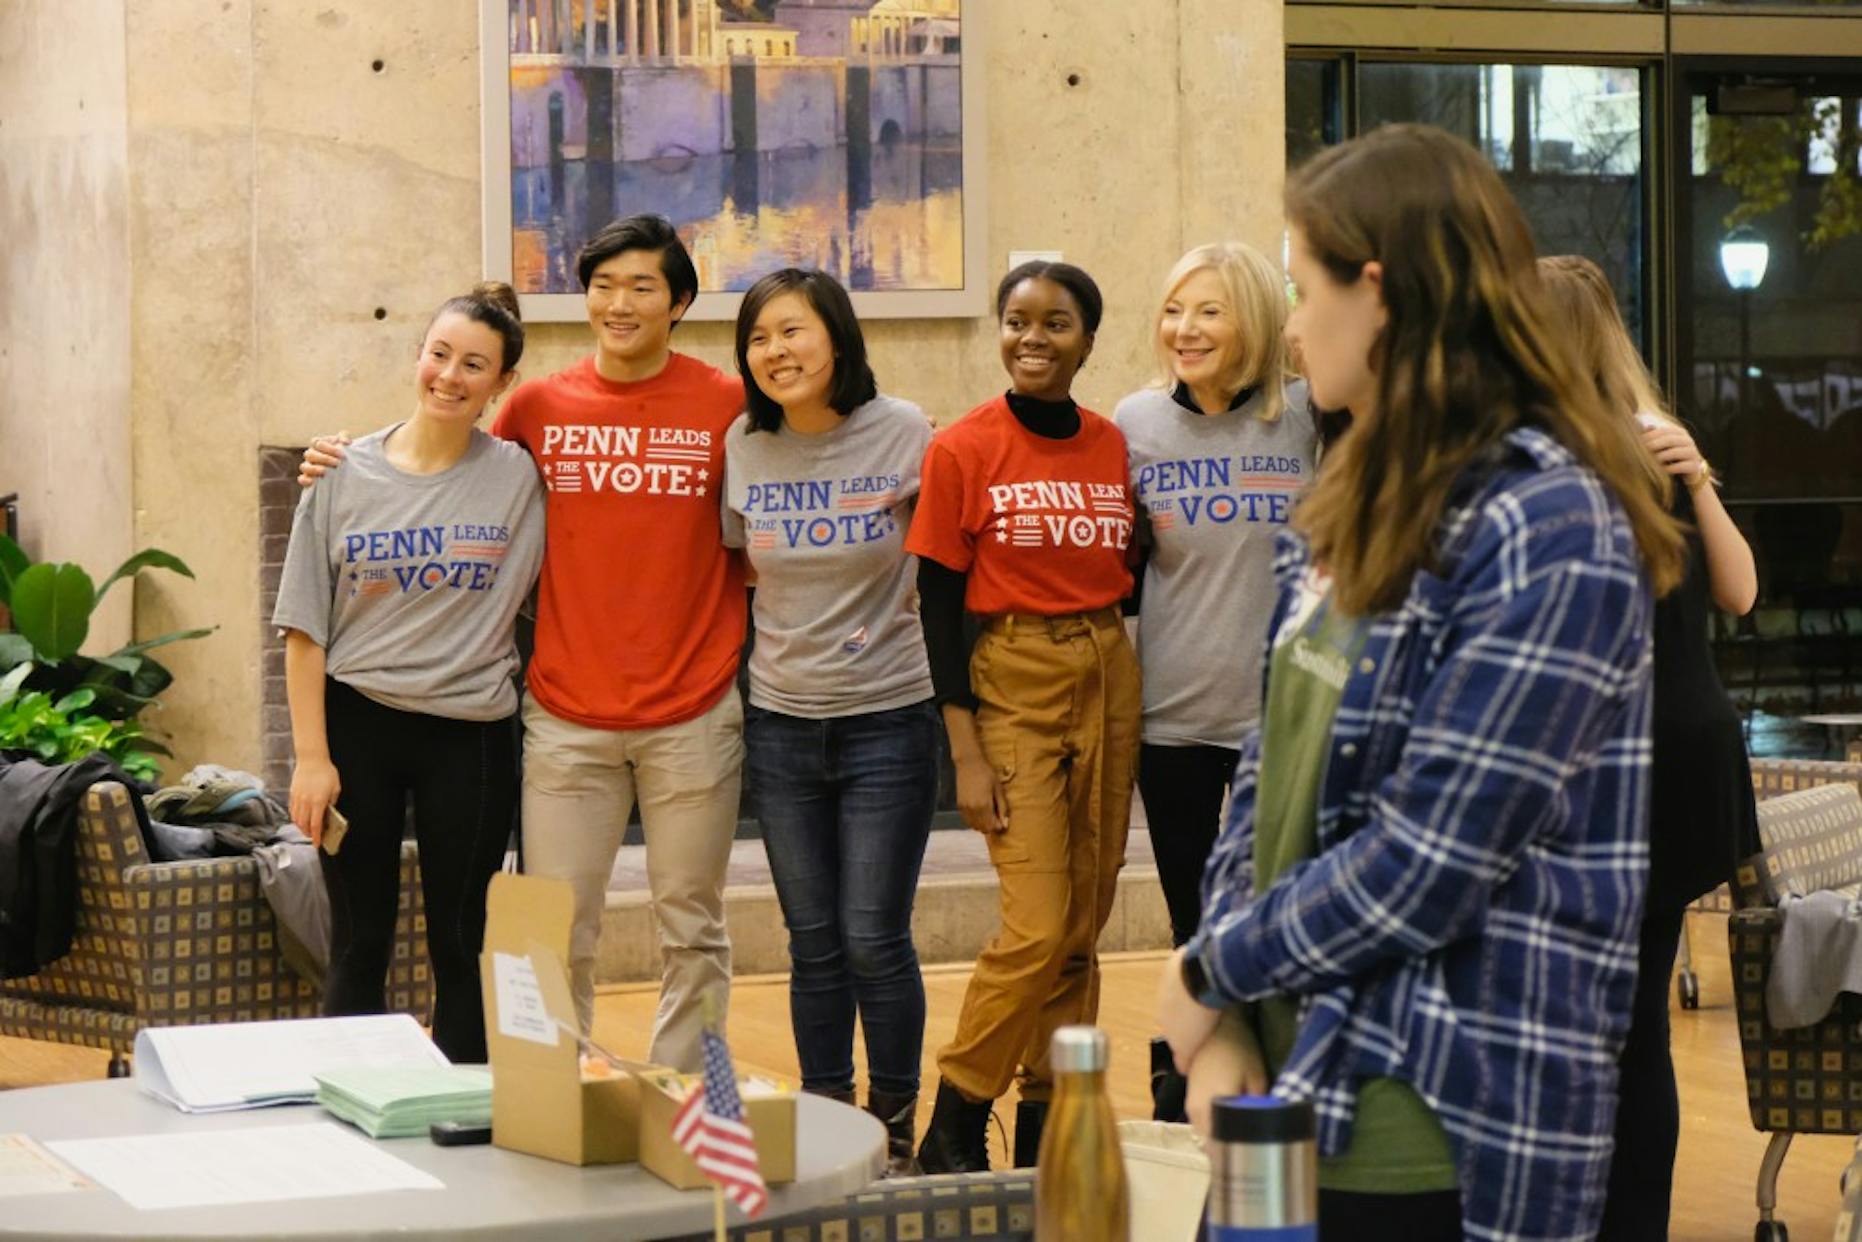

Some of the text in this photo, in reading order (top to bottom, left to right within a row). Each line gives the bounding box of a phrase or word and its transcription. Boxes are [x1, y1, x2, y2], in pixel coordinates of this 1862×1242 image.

[541, 425, 712, 457] PENN LEADS
[555, 461, 692, 496] THE VOTE
[1138, 456, 1300, 495] PENN LEADS
[742, 474, 900, 513] PENN LEADS
[988, 480, 1086, 513] PENN
[1151, 493, 1290, 526] THE VOTE
[345, 524, 509, 563] PENN LEADS
[755, 510, 885, 548] THE VOTE
[1013, 514, 1130, 550] THE VOTE
[362, 568, 388, 580] THE
